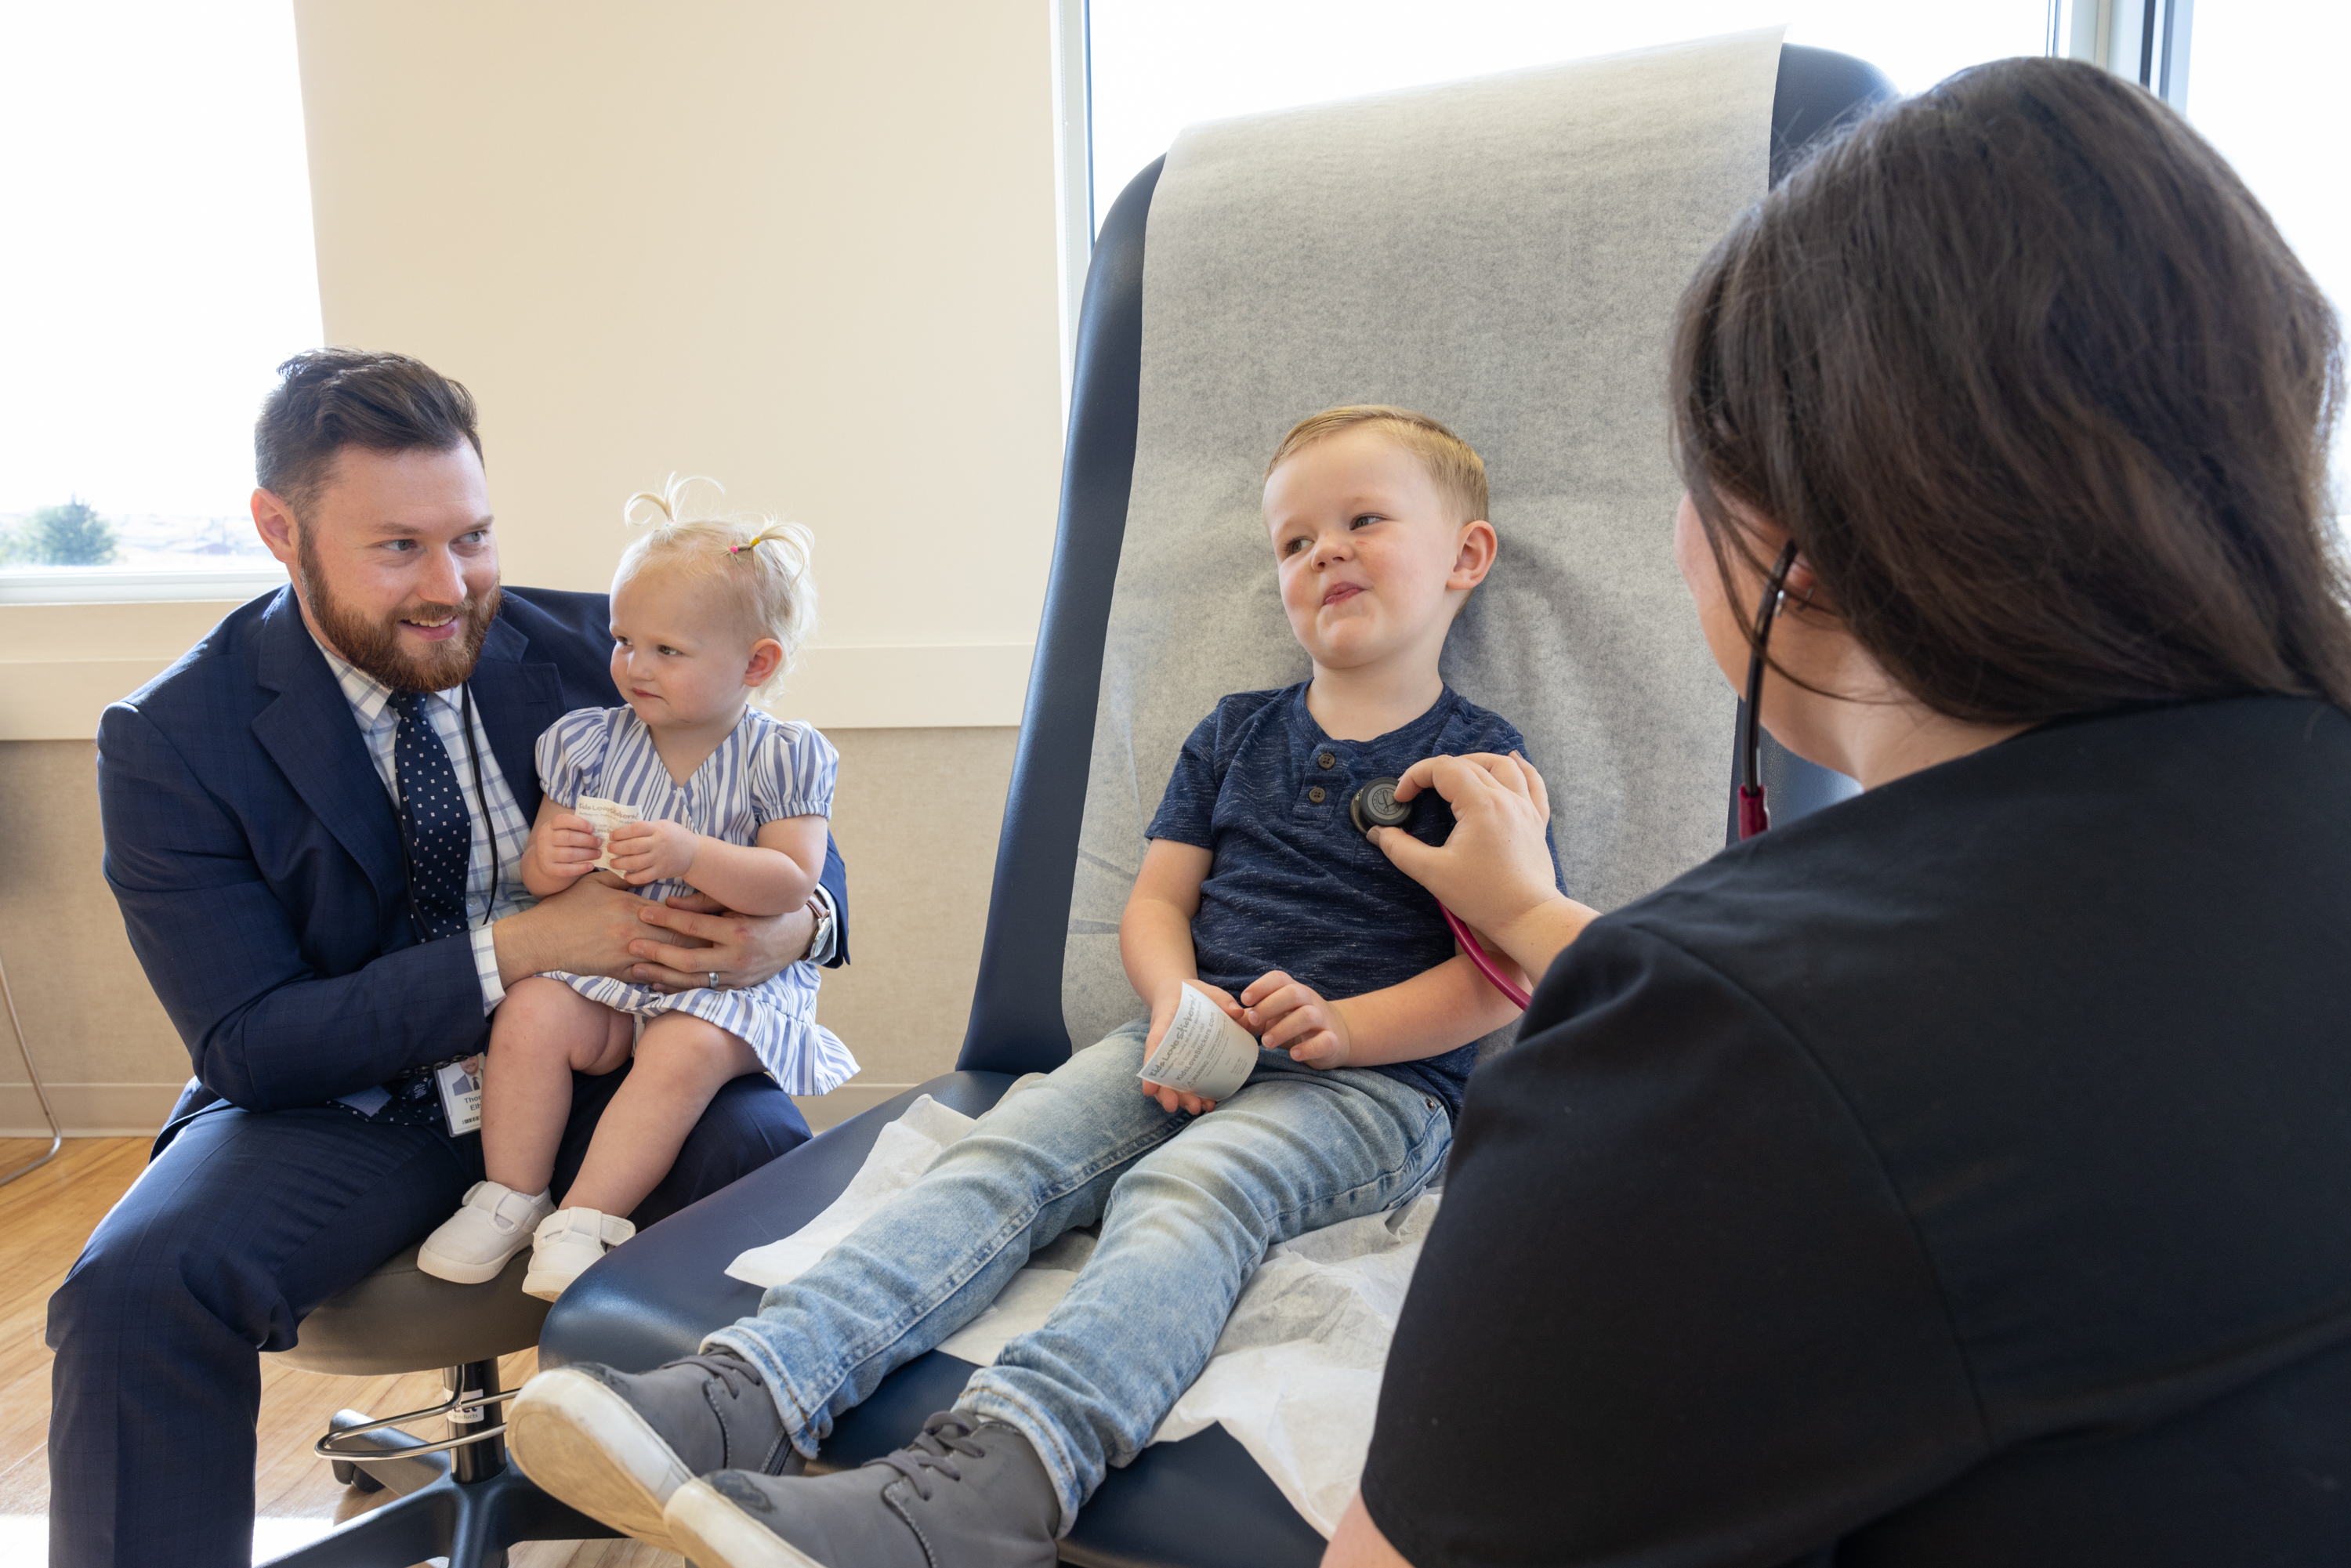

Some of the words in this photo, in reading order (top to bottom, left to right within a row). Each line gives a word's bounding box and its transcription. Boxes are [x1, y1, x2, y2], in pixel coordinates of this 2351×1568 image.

[1148, 1060, 1165, 1077] Kids
[1162, 1040, 1179, 1060] Love
[1176, 994, 1197, 1039] Stickers!
[1175, 1012, 1215, 1081] KidsLoveStickers.com
[1190, 1032, 1201, 1048] please
[1190, 1059, 1210, 1081] WARNING:
